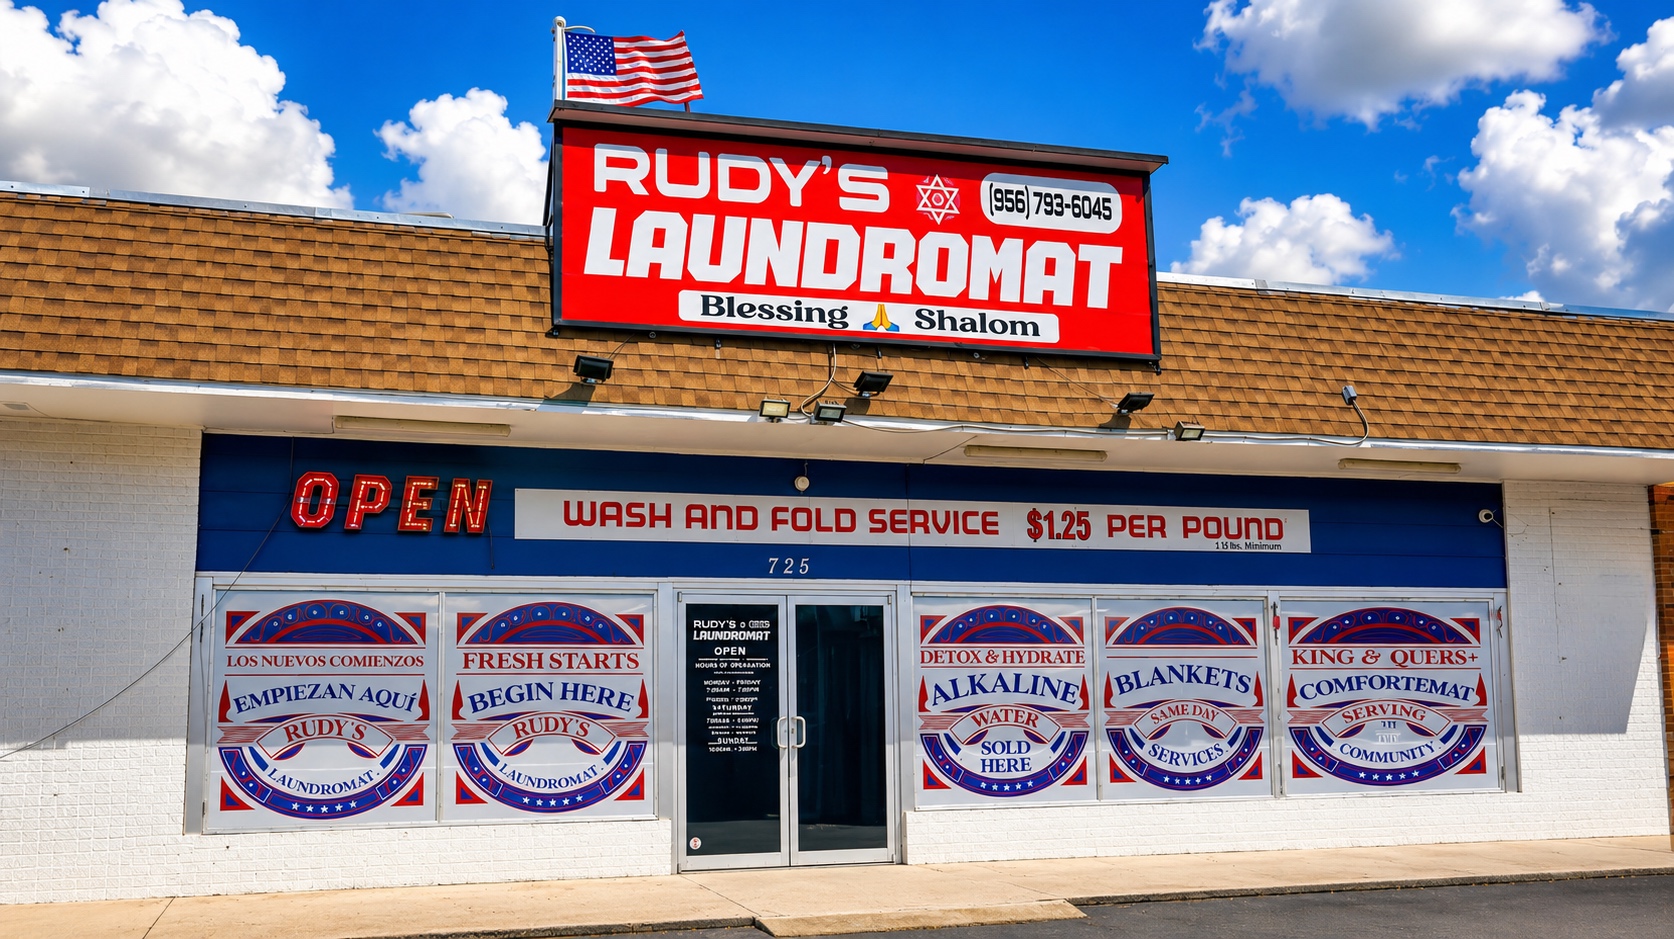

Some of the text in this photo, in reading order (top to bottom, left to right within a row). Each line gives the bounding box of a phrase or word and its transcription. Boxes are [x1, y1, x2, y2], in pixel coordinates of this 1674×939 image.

[593, 143, 889, 213] RUDY'S
[989, 182, 1113, 221] (956) 793-6045
[584, 206, 1124, 310] LAUNDROMAT
[700, 295, 1041, 337] Blessing Shalom
[290, 471, 493, 534] OPEN
[563, 500, 1284, 543] WASH AND FOLD SERVICE $1.25 PER POUND
[1244, 541, 1282, 551] Minimum
[693, 620, 737, 629] RUDY'S
[693, 630, 771, 641] LAUNDROMAT
[226, 655, 425, 667] LOS NUEVOS COMIENZOS
[462, 652, 640, 669] FRESH STARTS
[714, 646, 746, 656] OPEN
[920, 649, 1086, 664] DETOX & HYDRATE
[1291, 649, 1354, 665] KING
[1361, 649, 1381, 664] &
[932, 672, 1080, 707] ALKALINE
[1114, 664, 1252, 696] BLANKETS
[1299, 674, 1475, 702] COMFORTEMAT
[232, 683, 419, 714] EMPIEZAN AQUÍ
[467, 682, 635, 714] BEGIN HERE
[970, 709, 1039, 729] WATER
[1150, 704, 1219, 725] SAME DAY
[1341, 703, 1427, 724] SERVING
[283, 719, 367, 743] RUDY'S
[512, 716, 591, 740] RUDY'S
[980, 740, 1031, 755] SOLD
[1148, 742, 1224, 767] SERVICES
[1339, 741, 1436, 763] COMMUNITY
[499, 763, 598, 789] LAUNDROMAT
[980, 757, 1032, 773] HERE
[267, 767, 374, 795] LAUNDROMAT
